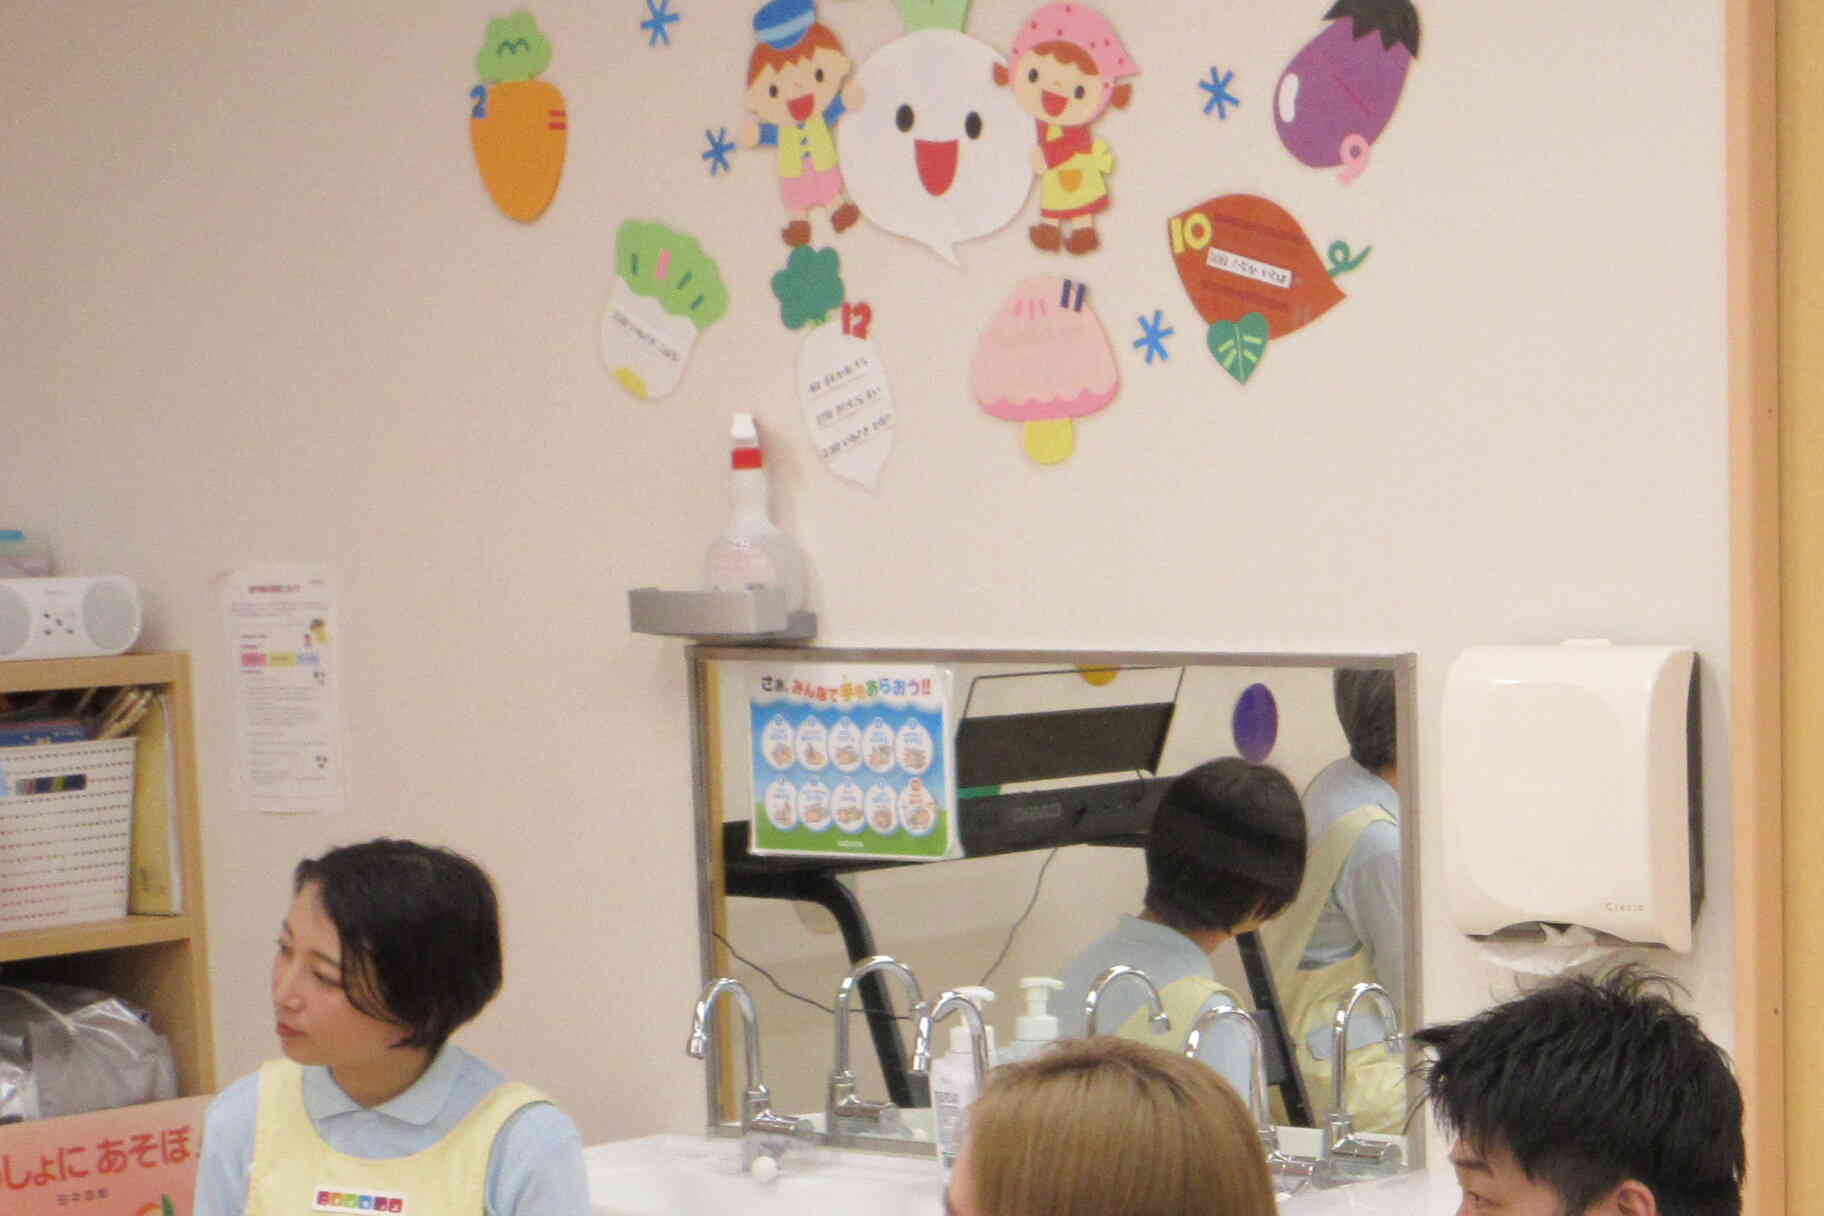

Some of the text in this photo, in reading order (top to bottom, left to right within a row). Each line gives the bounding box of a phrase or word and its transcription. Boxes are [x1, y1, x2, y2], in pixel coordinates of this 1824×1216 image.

[469, 85, 488, 119] 2
[1337, 133, 1368, 184] 9
[1170, 212, 1213, 254] 10
[841, 300, 872, 340] 12
[0, 1146, 89, 1190] しょに
